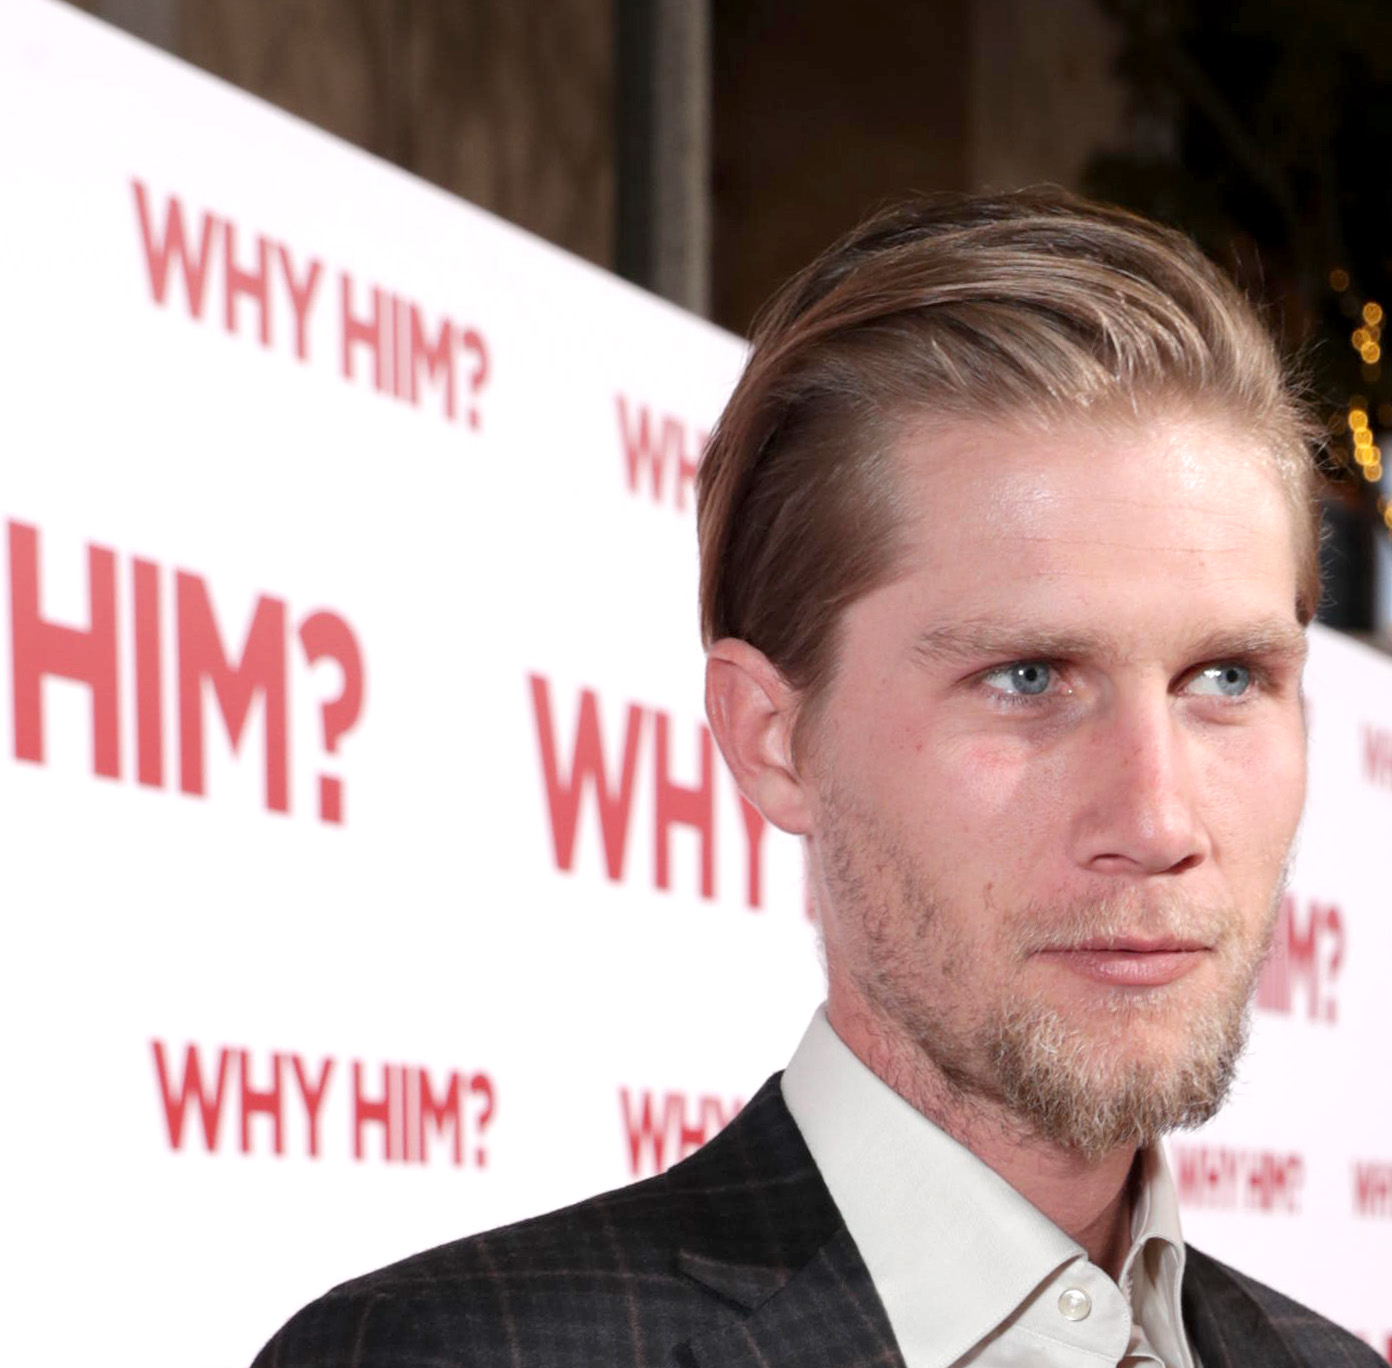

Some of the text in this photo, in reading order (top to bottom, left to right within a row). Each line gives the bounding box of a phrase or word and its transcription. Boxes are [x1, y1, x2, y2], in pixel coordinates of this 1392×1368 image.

[130, 175, 491, 431] WHY HIM?
[7, 518, 366, 826] HIM?
[151, 1040, 494, 1167] WHY HIM?
